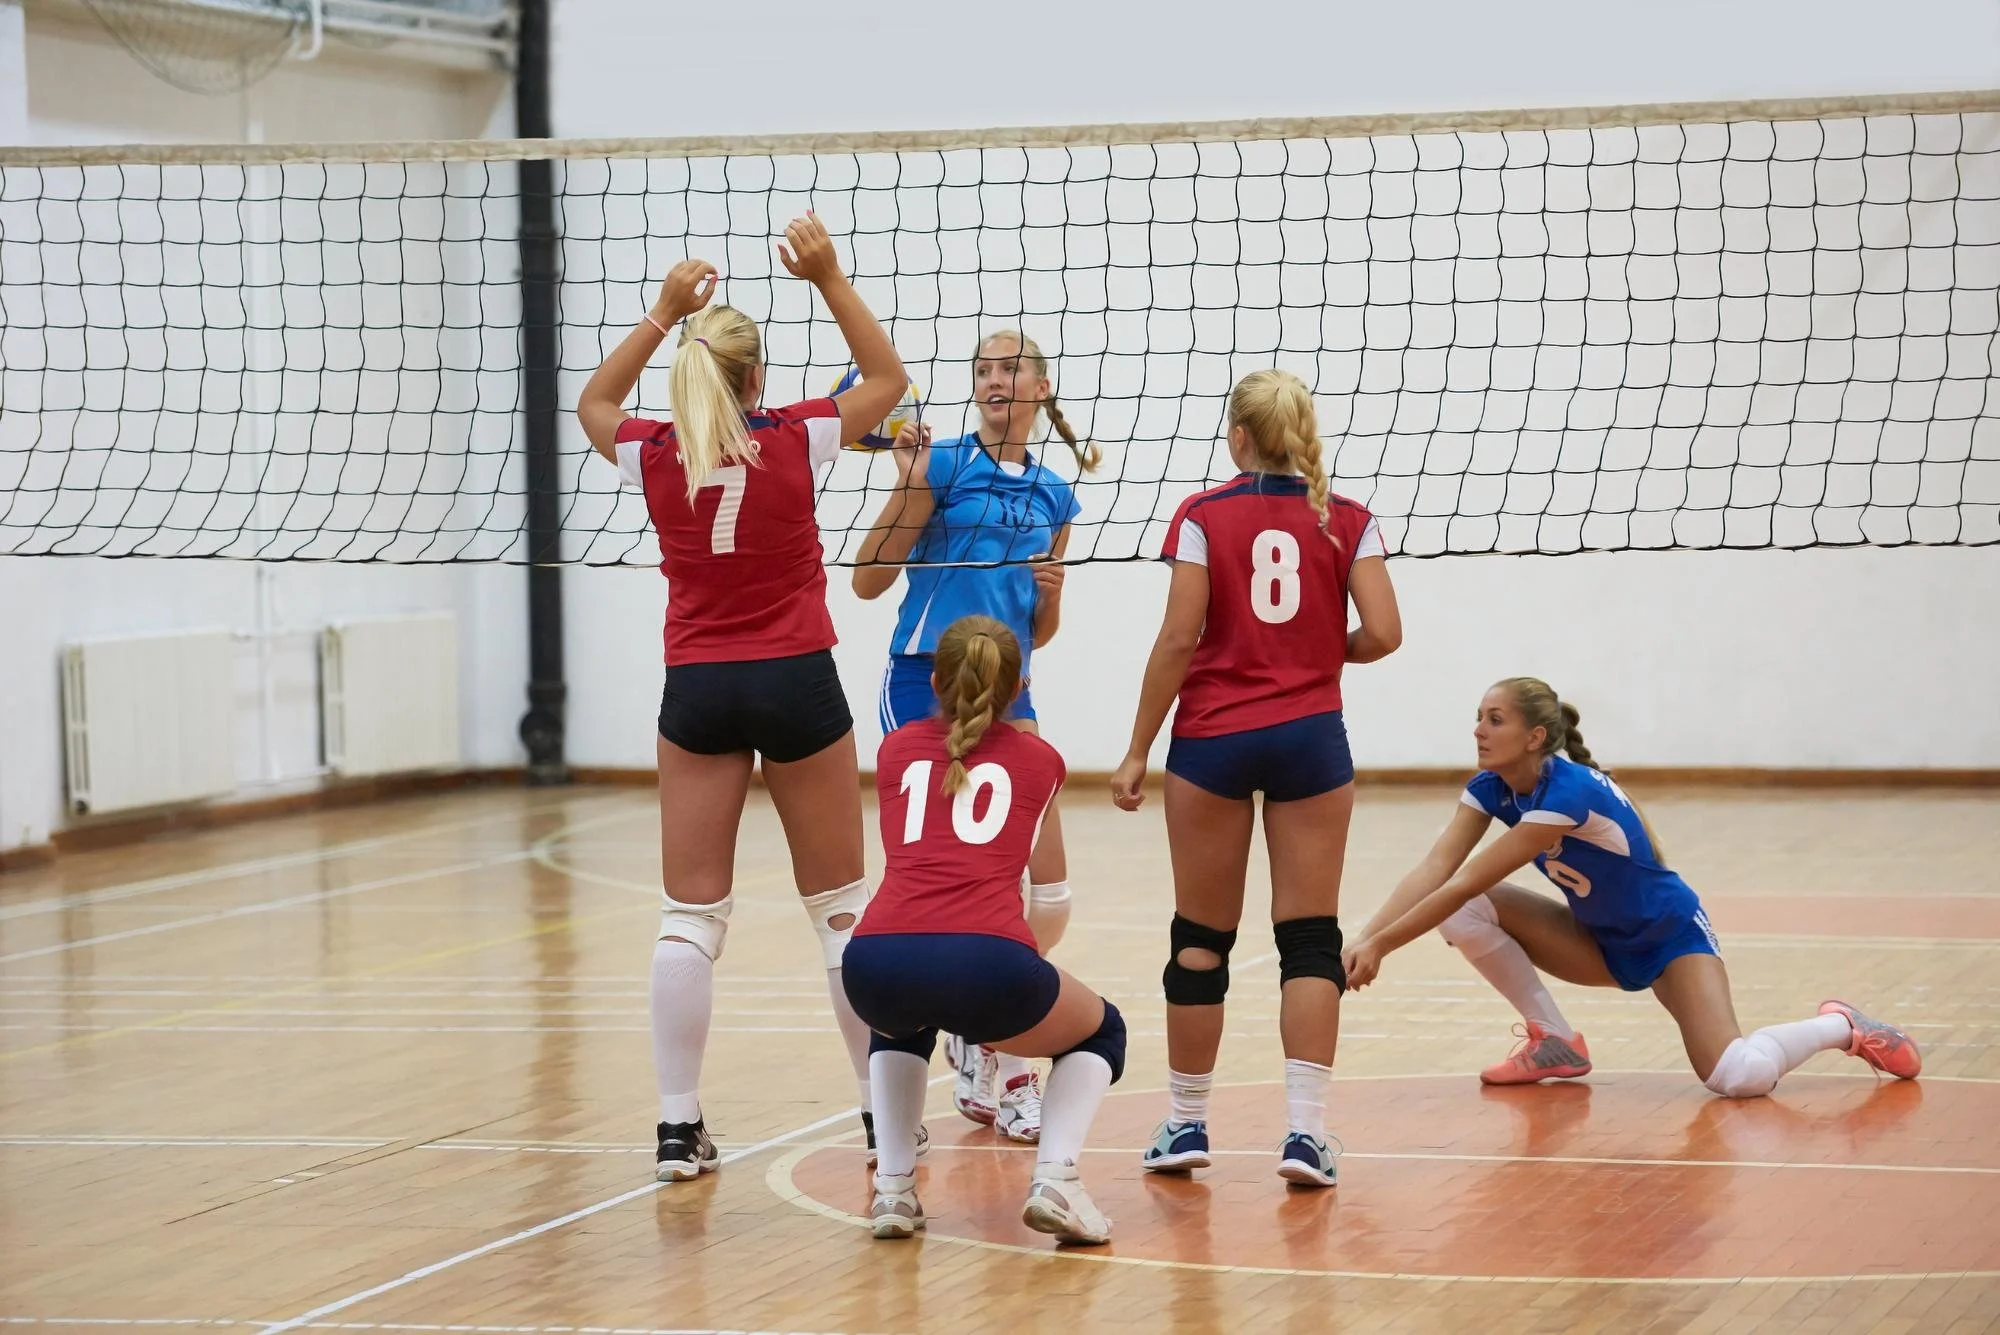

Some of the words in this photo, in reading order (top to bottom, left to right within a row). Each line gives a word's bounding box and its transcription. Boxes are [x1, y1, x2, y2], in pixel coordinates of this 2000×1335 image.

[698, 464, 747, 554] 7
[1250, 529, 1301, 624] 8
[899, 760, 1013, 845] 10
